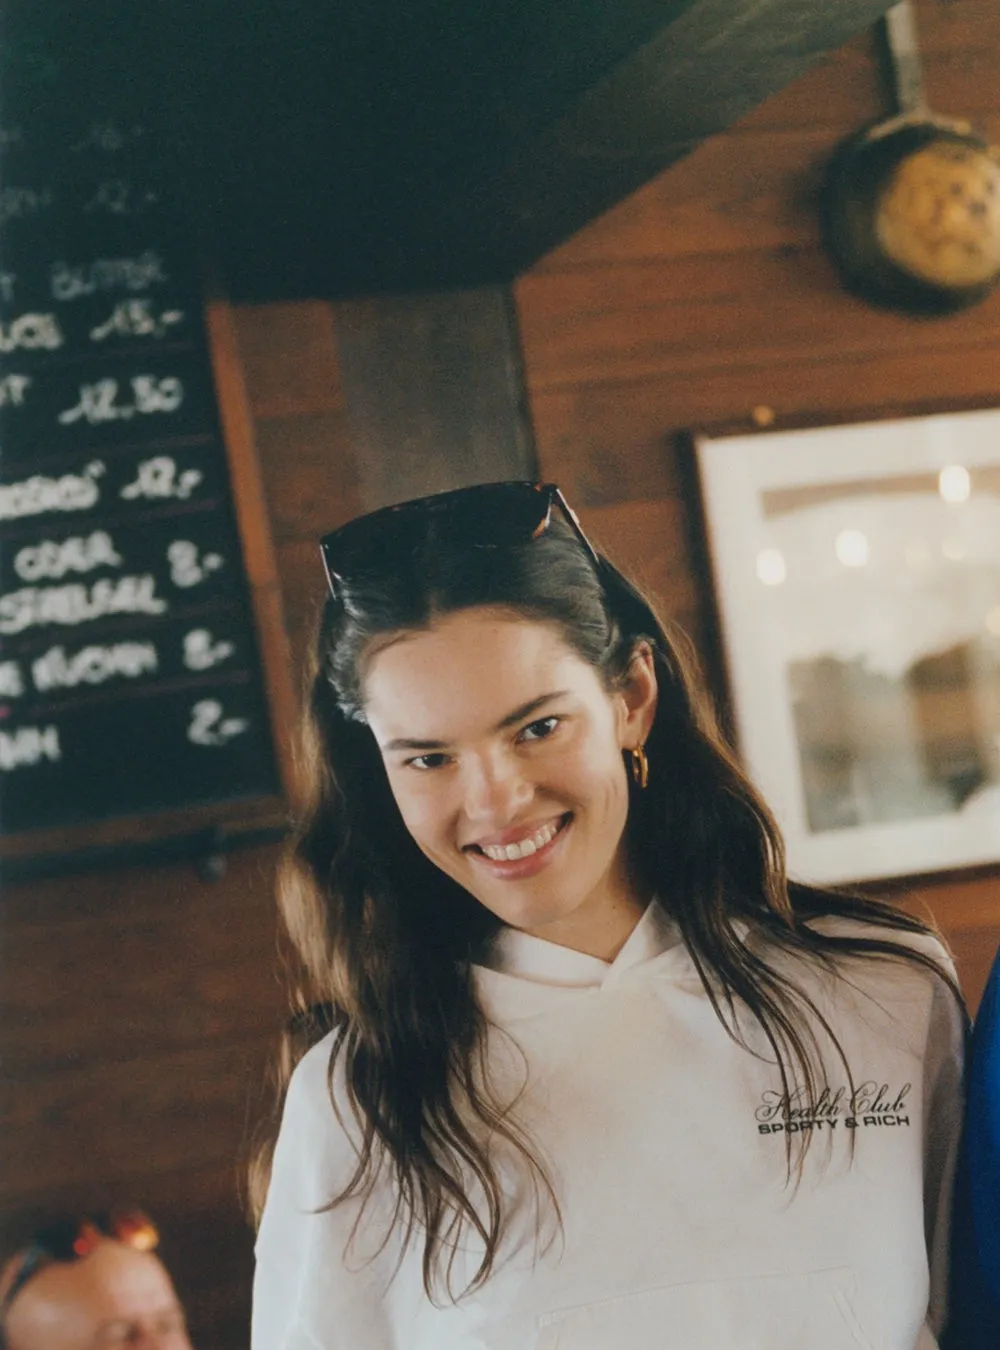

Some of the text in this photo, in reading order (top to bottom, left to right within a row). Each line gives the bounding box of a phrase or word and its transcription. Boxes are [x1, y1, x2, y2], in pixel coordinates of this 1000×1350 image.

[755, 1081, 912, 1122] Health Club
[758, 1115, 911, 1135] SPORTY & RICH
